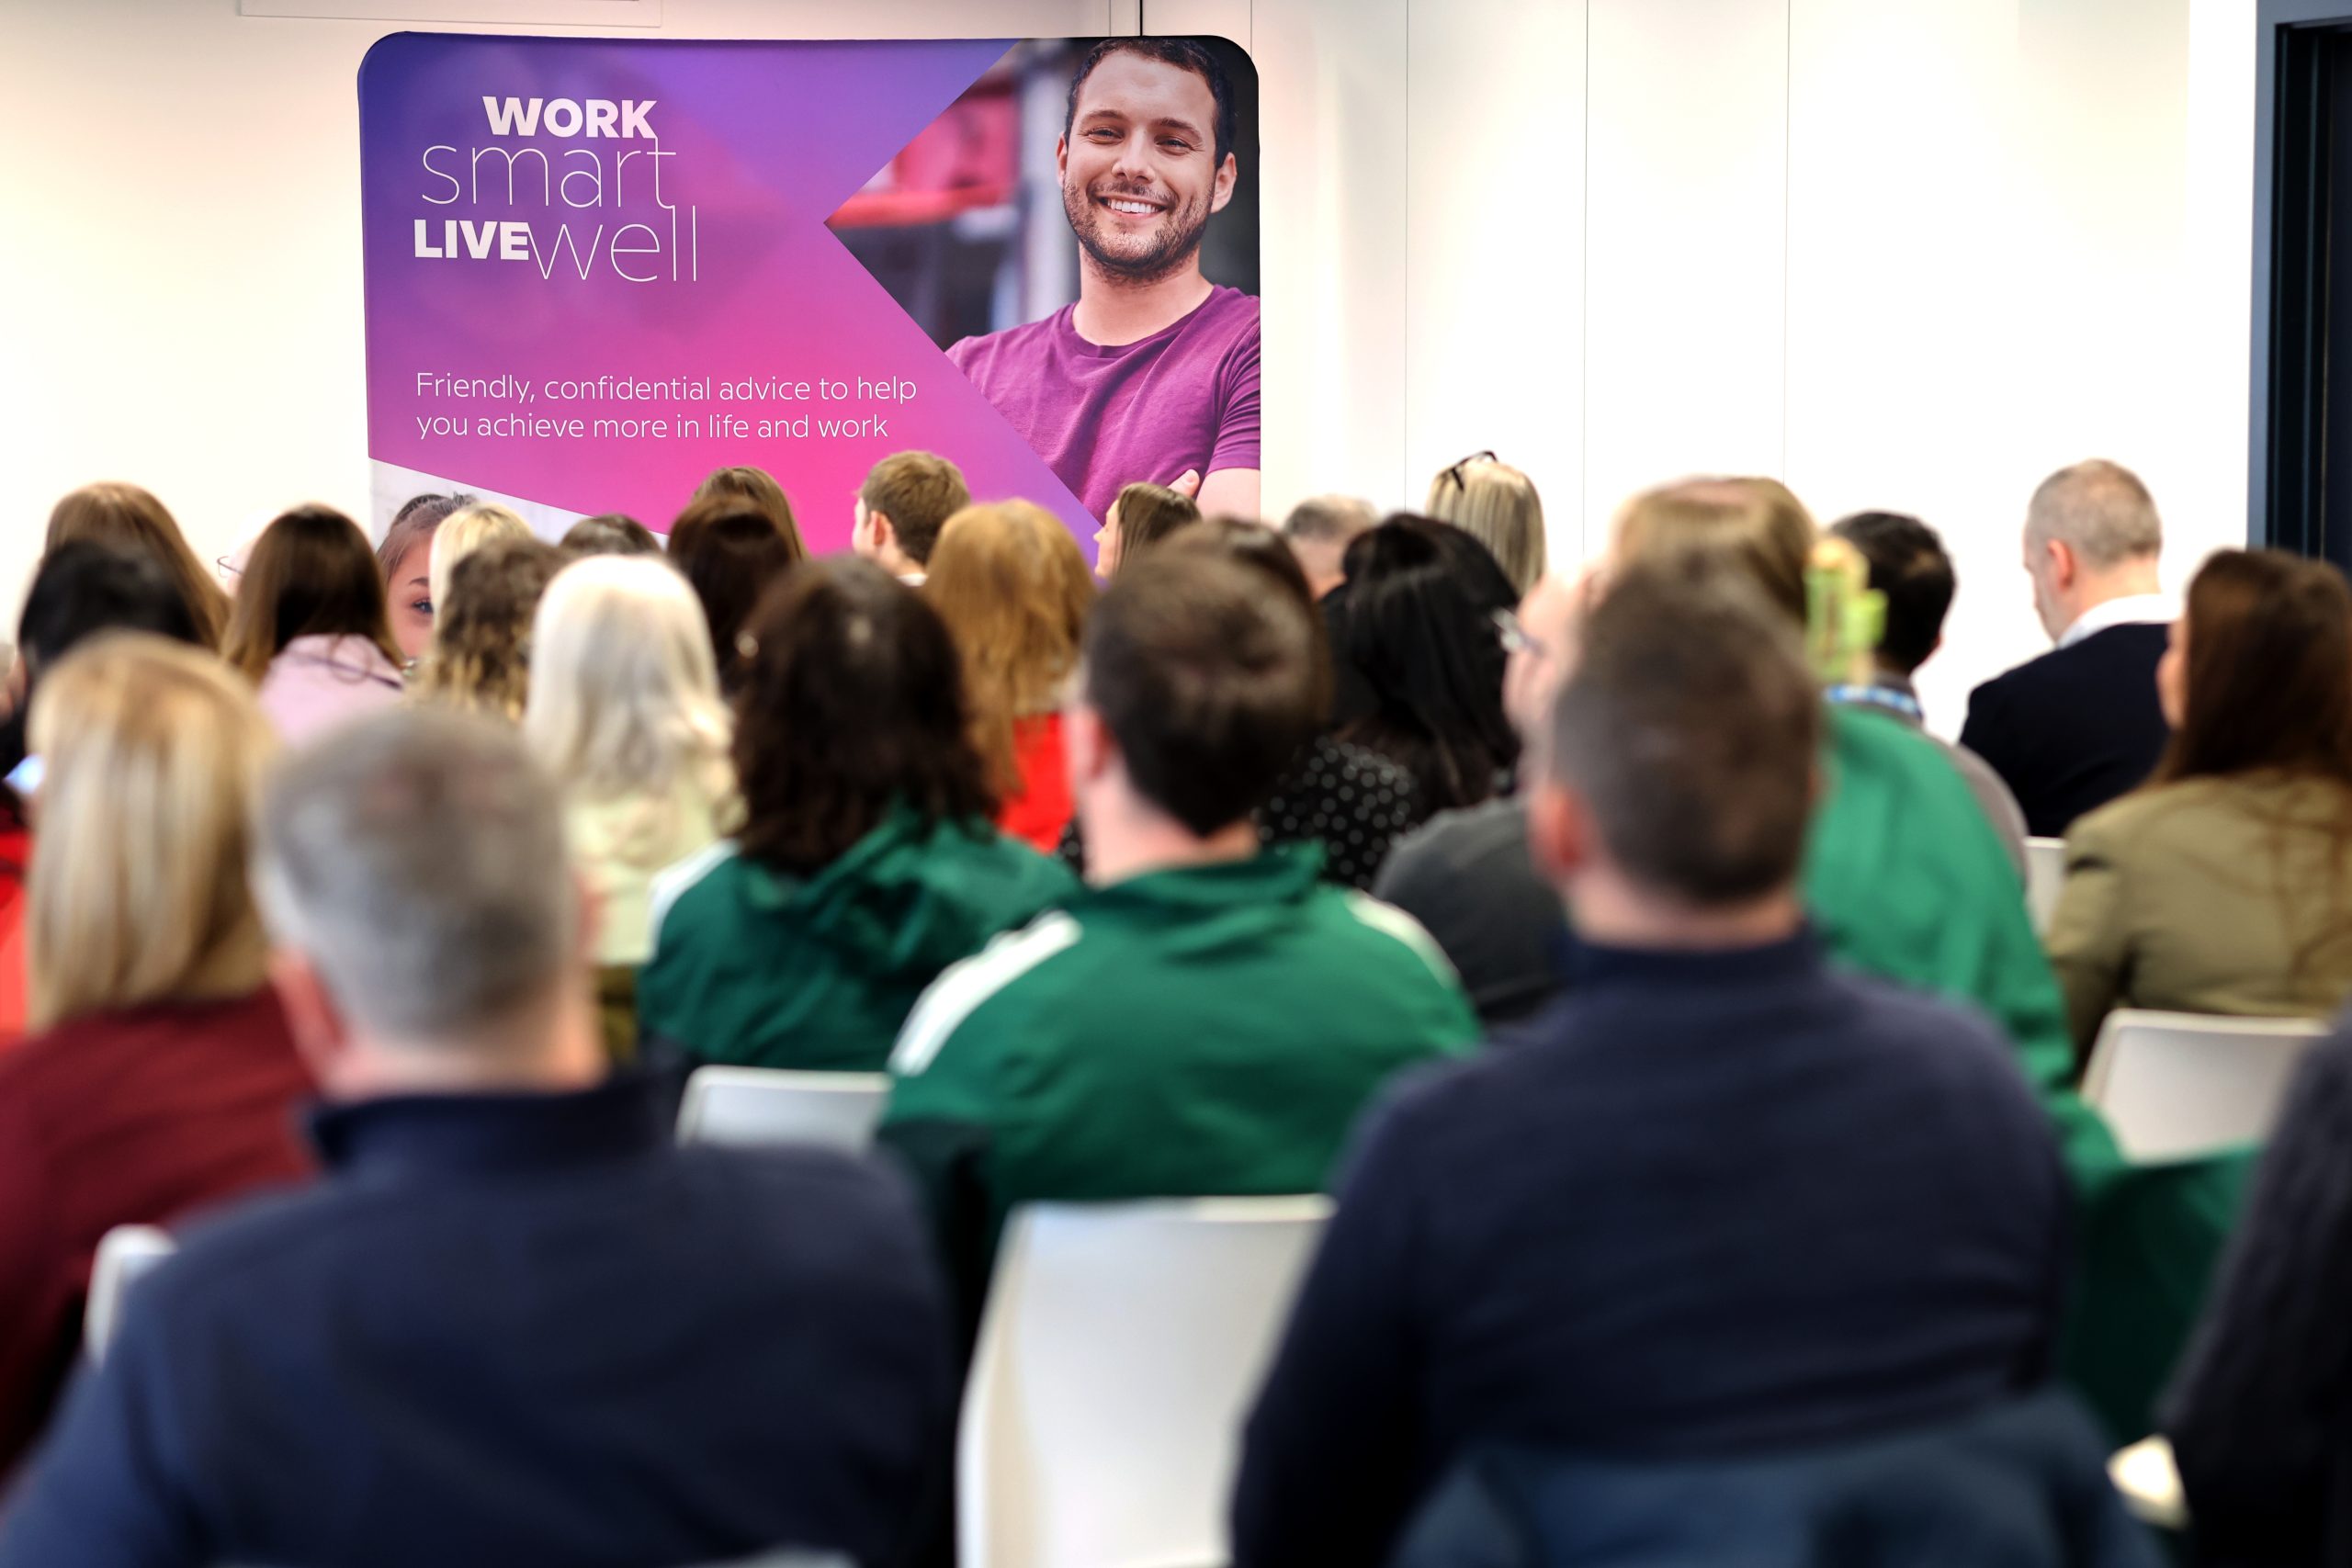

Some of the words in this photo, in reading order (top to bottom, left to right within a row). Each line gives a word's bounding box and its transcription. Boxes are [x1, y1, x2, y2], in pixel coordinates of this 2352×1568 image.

[482, 95, 657, 139] WORK
[421, 137, 677, 209] smart
[413, 219, 530, 261] LIVE
[527, 204, 697, 282] well
[416, 372, 536, 406] Friendly,
[544, 375, 711, 401] confidential
[719, 376, 811, 401] advice
[819, 378, 849, 401] to
[857, 375, 917, 406] help
[416, 416, 469, 441] you
[477, 412, 585, 439] achieve
[594, 418, 669, 439] more
[676, 412, 700, 439] in
[709, 412, 751, 439] life
[757, 413, 809, 439] and
[818, 413, 889, 439] work
